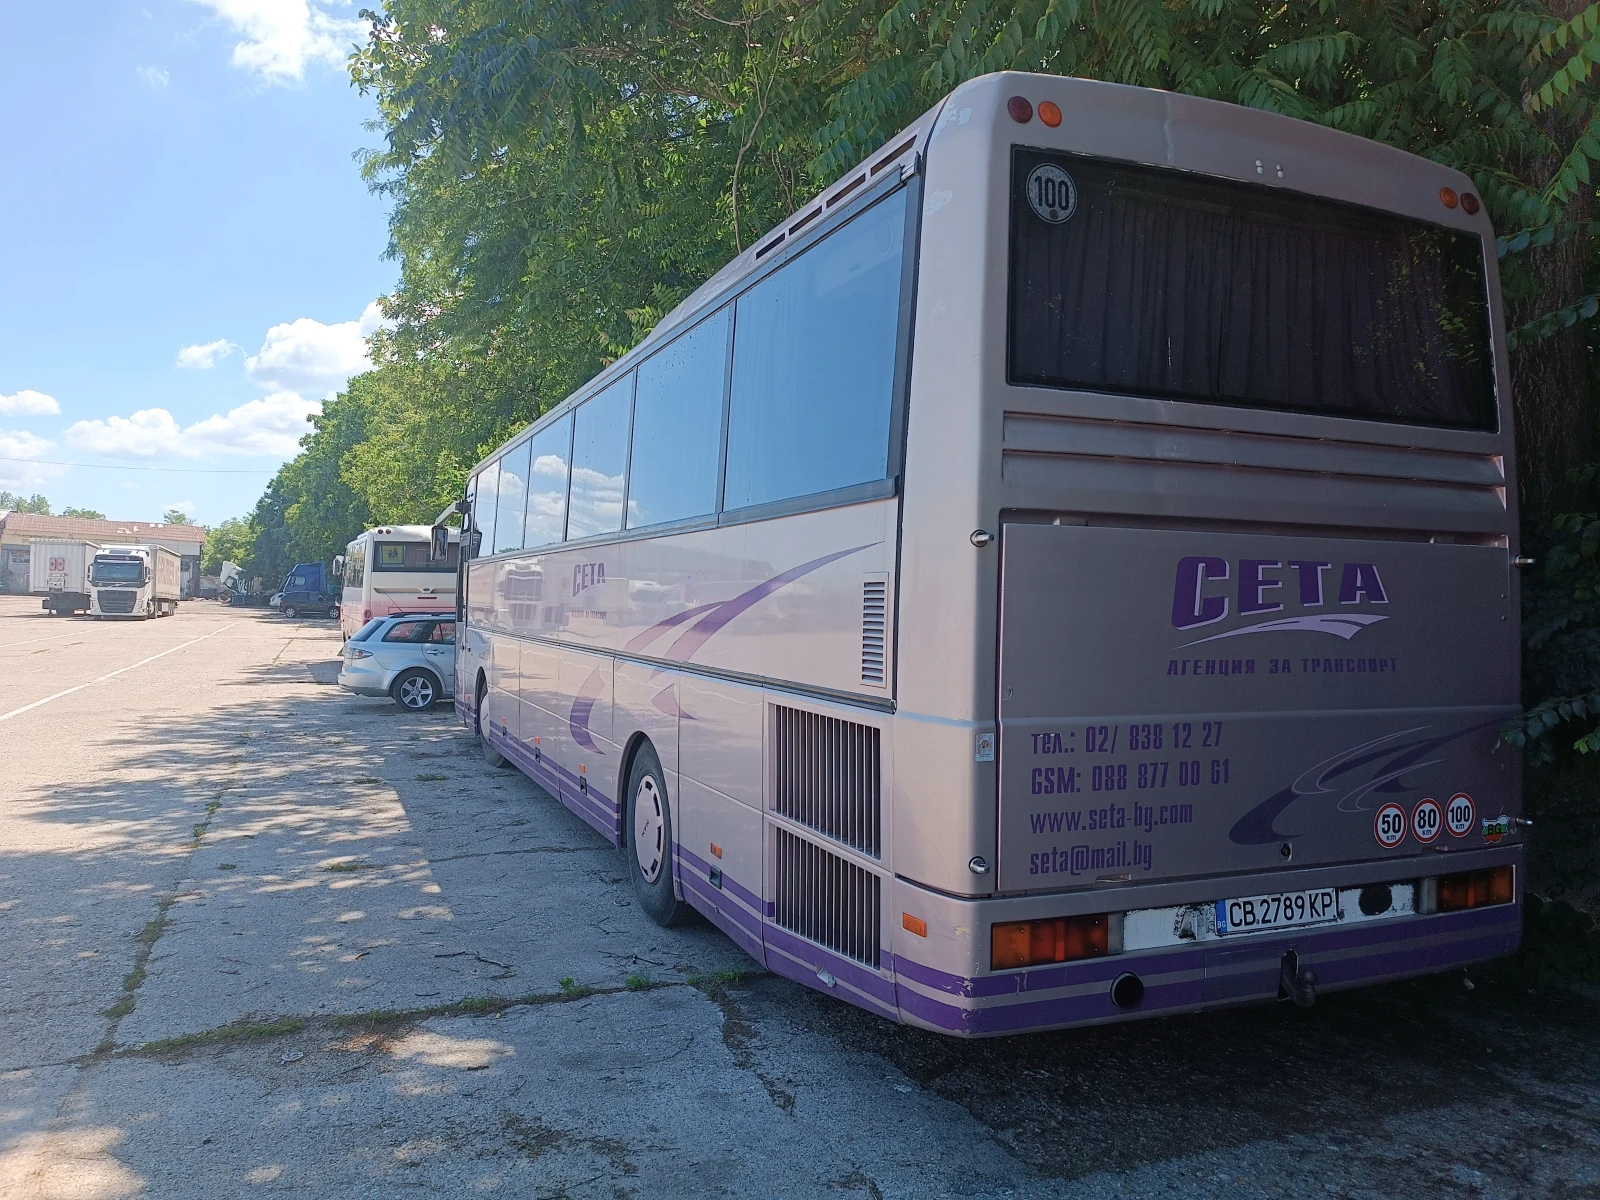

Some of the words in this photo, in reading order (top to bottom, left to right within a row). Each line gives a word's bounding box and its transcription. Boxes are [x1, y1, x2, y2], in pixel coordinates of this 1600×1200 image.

[1034, 176, 1070, 211] 100
[572, 562, 606, 597] СЕТА
[1171, 556, 1389, 630] СЕТА
[1166, 658, 1255, 677] АГЕНЦИЯ
[1269, 658, 1292, 674] ЗА
[1301, 657, 1398, 673] ТРАНСПОРТ
[1085, 725, 1119, 754] 02/
[1129, 723, 1163, 751] 838
[1172, 722, 1192, 749] 12
[1202, 721, 1223, 748] 27
[1031, 766, 1081, 795] GSM:
[1092, 764, 1128, 792] 088
[1138, 761, 1169, 789] 877
[1179, 760, 1201, 786] 00
[1211, 758, 1229, 785] 61
[1030, 801, 1193, 834] www.seta-bg.com
[1381, 813, 1401, 835] 50
[1417, 808, 1437, 830] 80
[1449, 804, 1471, 824] 100
[1487, 823, 1502, 835] BG
[1029, 840, 1153, 876] seta@mail.bg
[1217, 920, 1226, 929] BG
